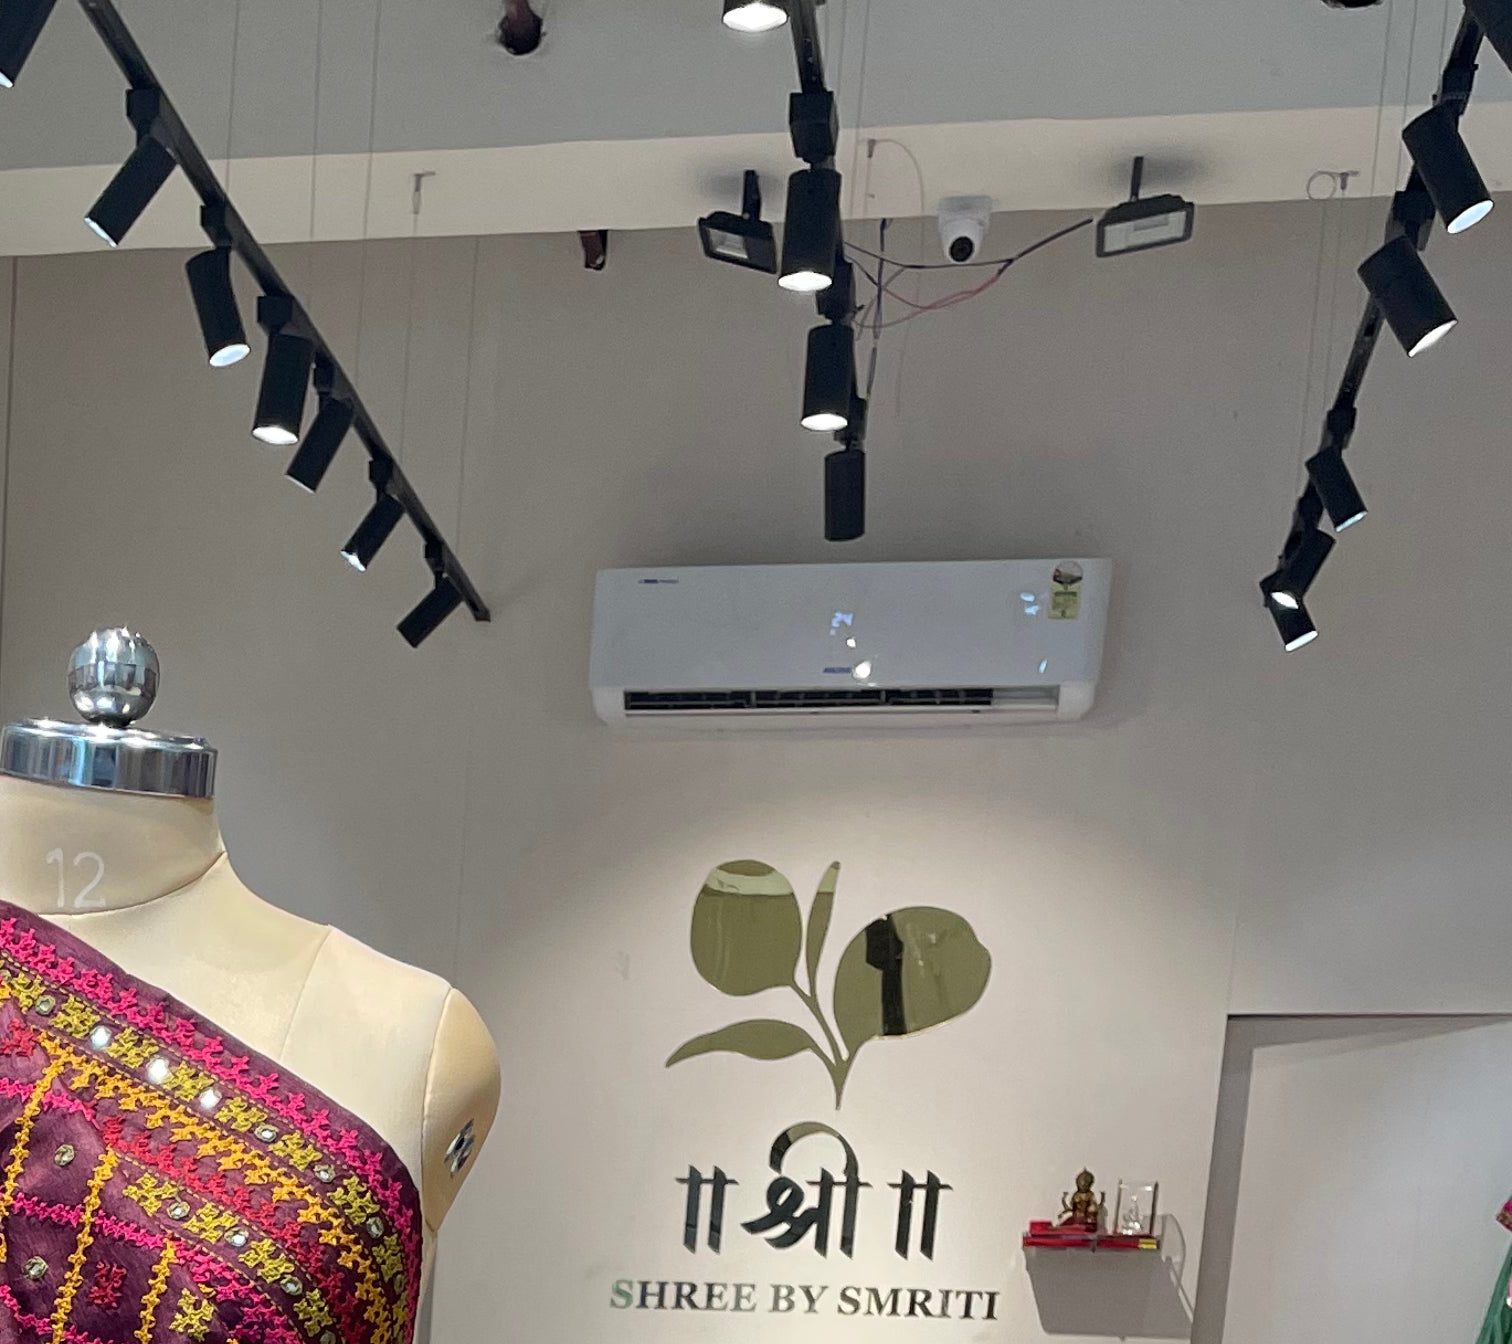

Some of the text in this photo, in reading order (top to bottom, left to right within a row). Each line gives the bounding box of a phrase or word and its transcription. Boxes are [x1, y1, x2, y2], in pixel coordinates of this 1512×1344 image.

[47, 848, 105, 908] 12
[609, 1279, 1000, 1321] SHREE BY SMRITI
